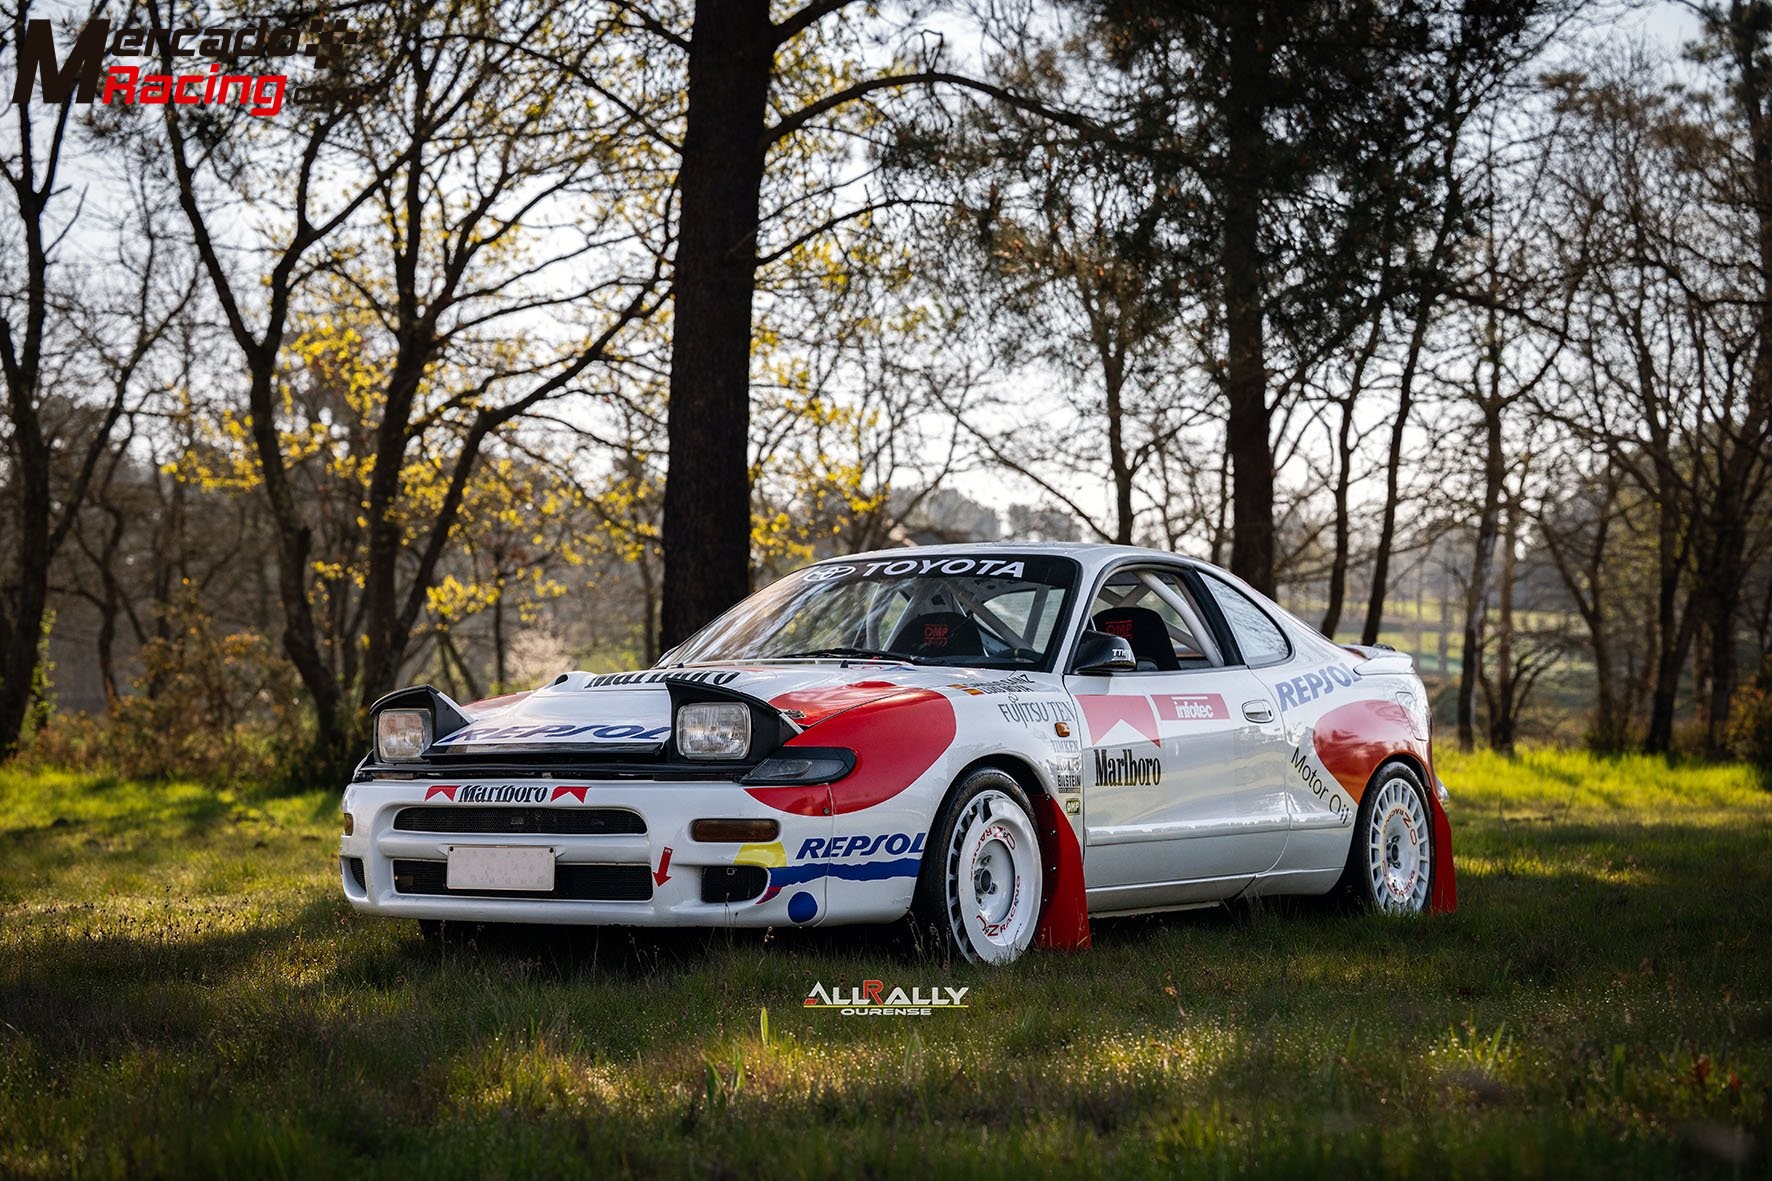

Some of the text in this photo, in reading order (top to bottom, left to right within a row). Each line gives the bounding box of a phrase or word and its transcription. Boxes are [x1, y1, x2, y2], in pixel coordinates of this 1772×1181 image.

[862, 559, 1025, 578] TOYOTA
[1275, 662, 1362, 713] REPSOL
[998, 701, 1076, 728] FUJITSU TEN
[1173, 701, 1214, 719] infotec
[438, 723, 671, 744] REPSOL
[1094, 748, 1161, 787] Marlboro
[457, 785, 548, 803] Marlboro
[1290, 747, 1349, 824] Motor Oil
[796, 832, 927, 860] REPSOL
